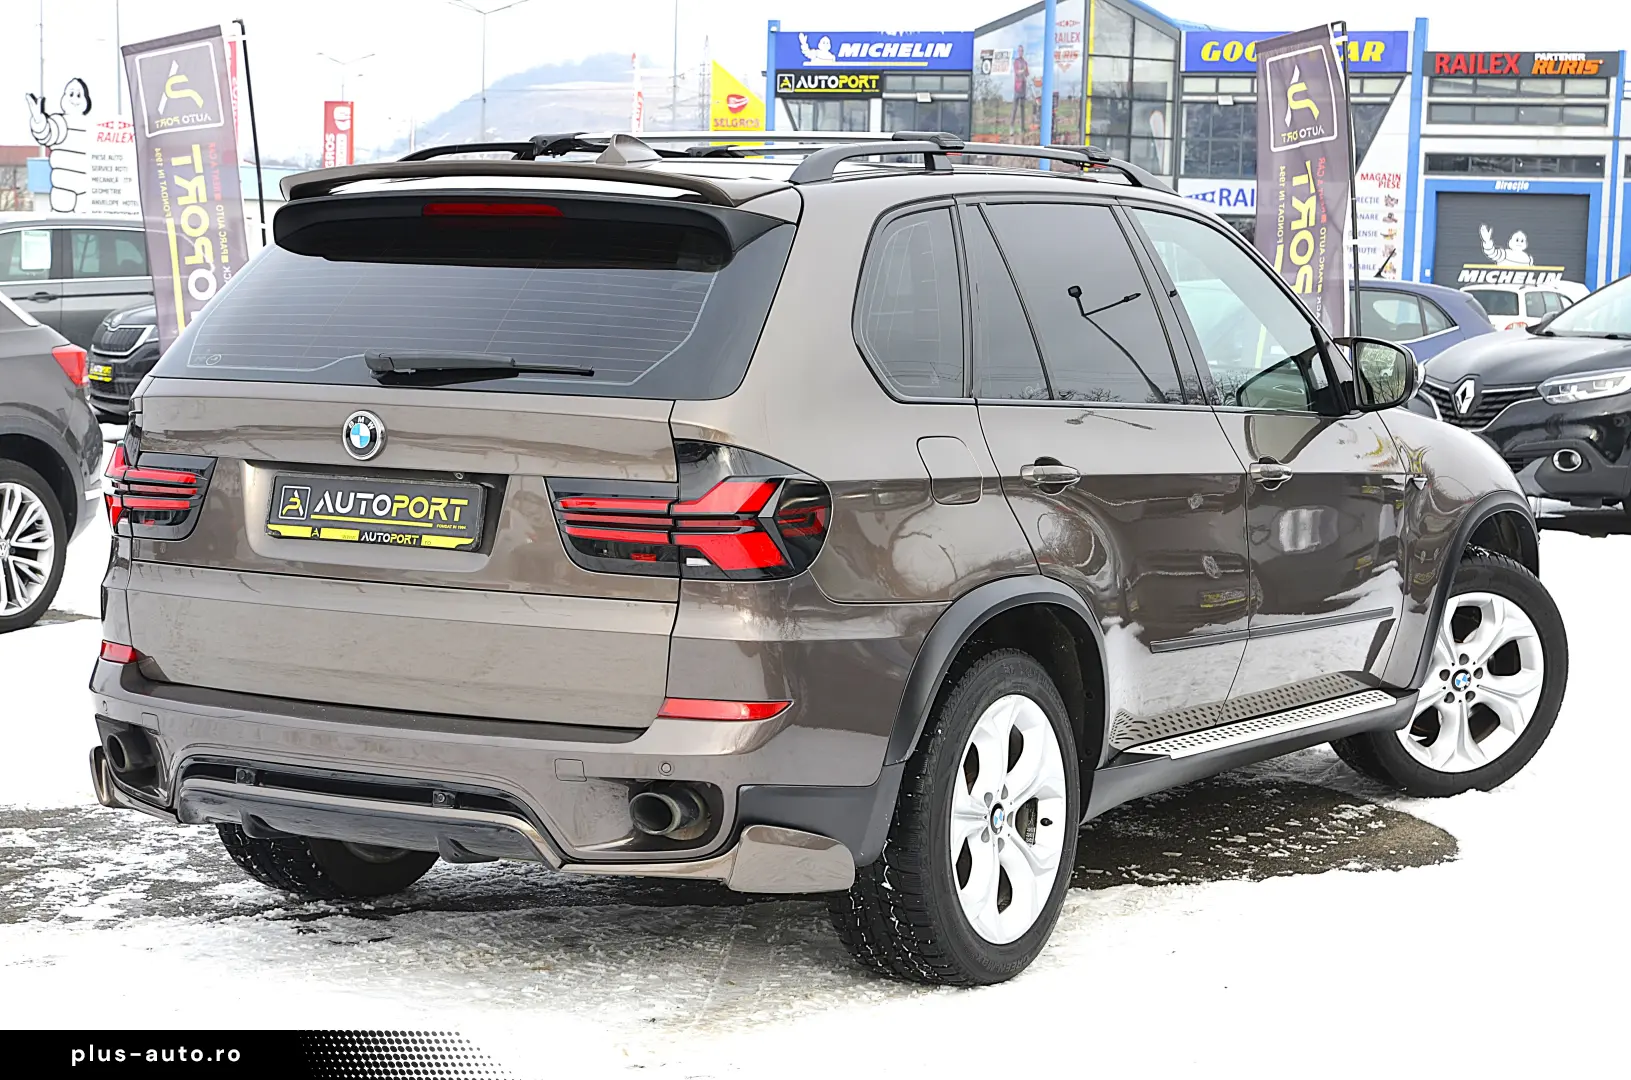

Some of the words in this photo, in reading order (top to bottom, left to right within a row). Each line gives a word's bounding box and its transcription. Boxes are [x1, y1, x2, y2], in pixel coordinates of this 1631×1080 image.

[838, 43, 953, 58] MICHELIN
[1201, 41, 1386, 62] GOOAR
[1435, 53, 1521, 75] RAILEX
[1531, 60, 1600, 75] RURIS
[796, 75, 880, 89] AUTOPORT
[714, 118, 760, 129] SELGROS
[97, 132, 134, 143] RAILEX
[1360, 173, 1401, 181] MAGAZIN
[1378, 180, 1401, 189] PIESE
[1219, 188, 1255, 207] RAI
[1458, 270, 1564, 286] MICHELIN
[348, 416, 376, 430] BMW
[313, 490, 469, 523] AUTOPORT
[360, 532, 419, 545] AUTOPORT
